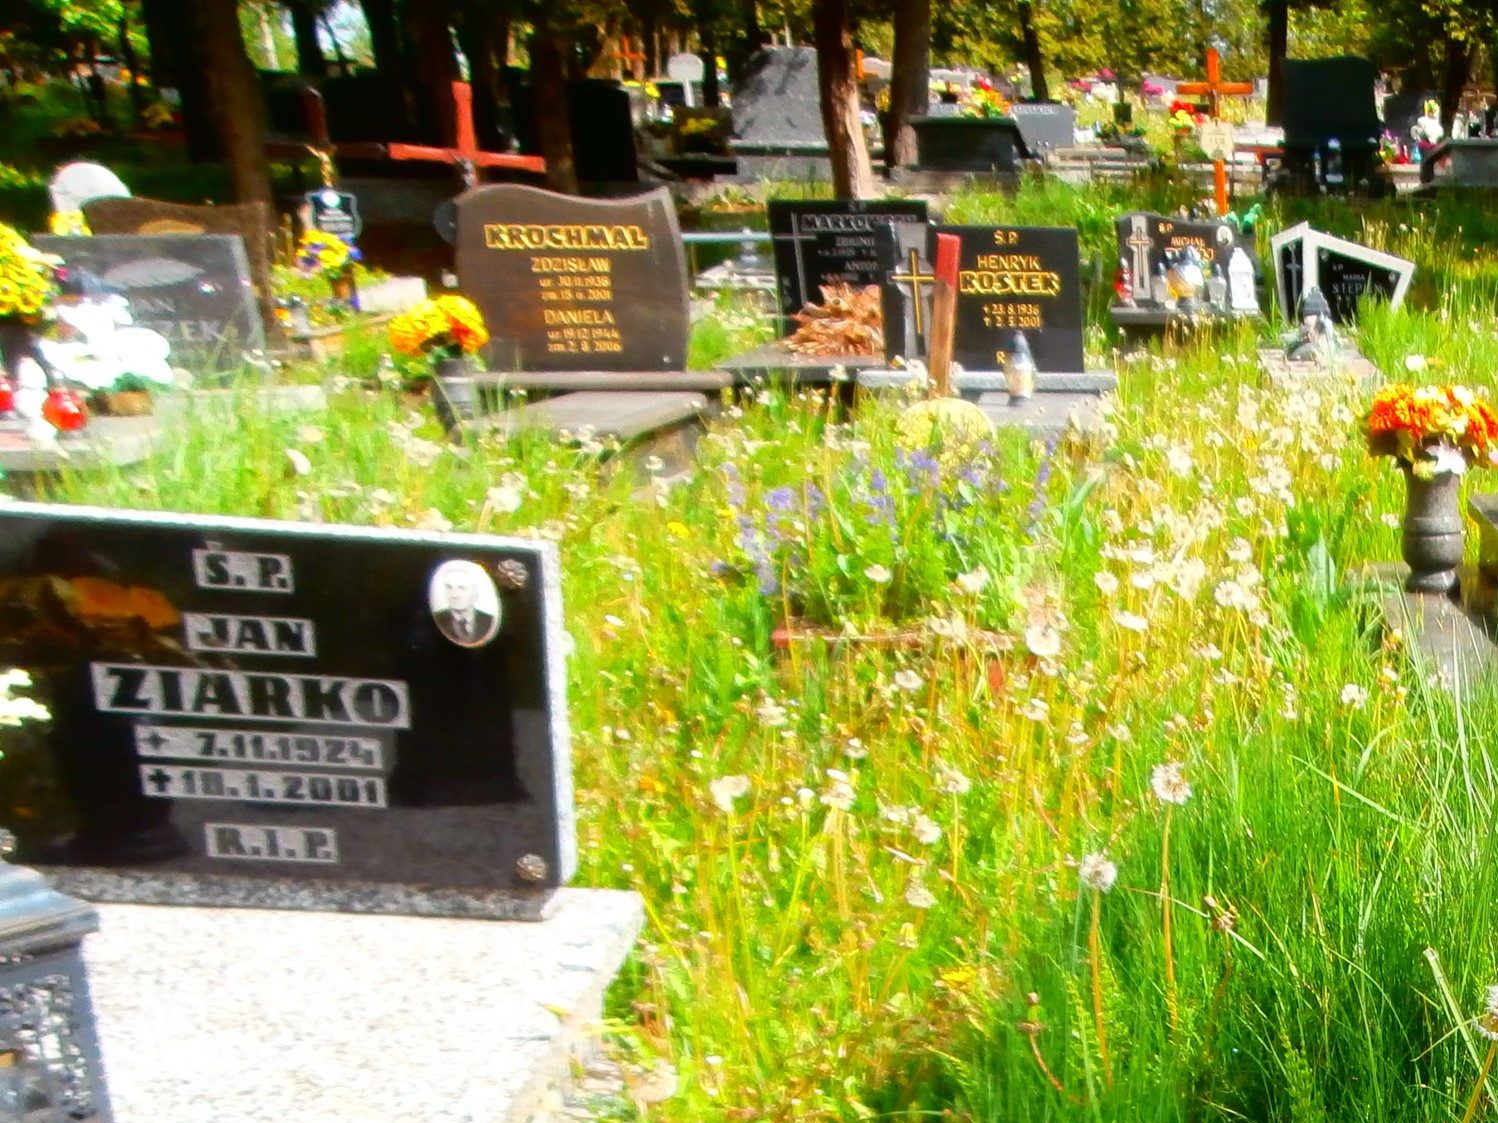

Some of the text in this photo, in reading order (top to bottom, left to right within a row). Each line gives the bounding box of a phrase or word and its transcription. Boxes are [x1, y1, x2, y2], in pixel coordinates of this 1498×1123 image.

[484, 224, 649, 249] KROCHMAL
[977, 255, 1041, 270] HENRYK
[959, 270, 1062, 296] ROSTEK
[543, 309, 616, 324] DANIELA
[198, 617, 305, 652] JAN
[106, 666, 400, 723] ZIARKO
